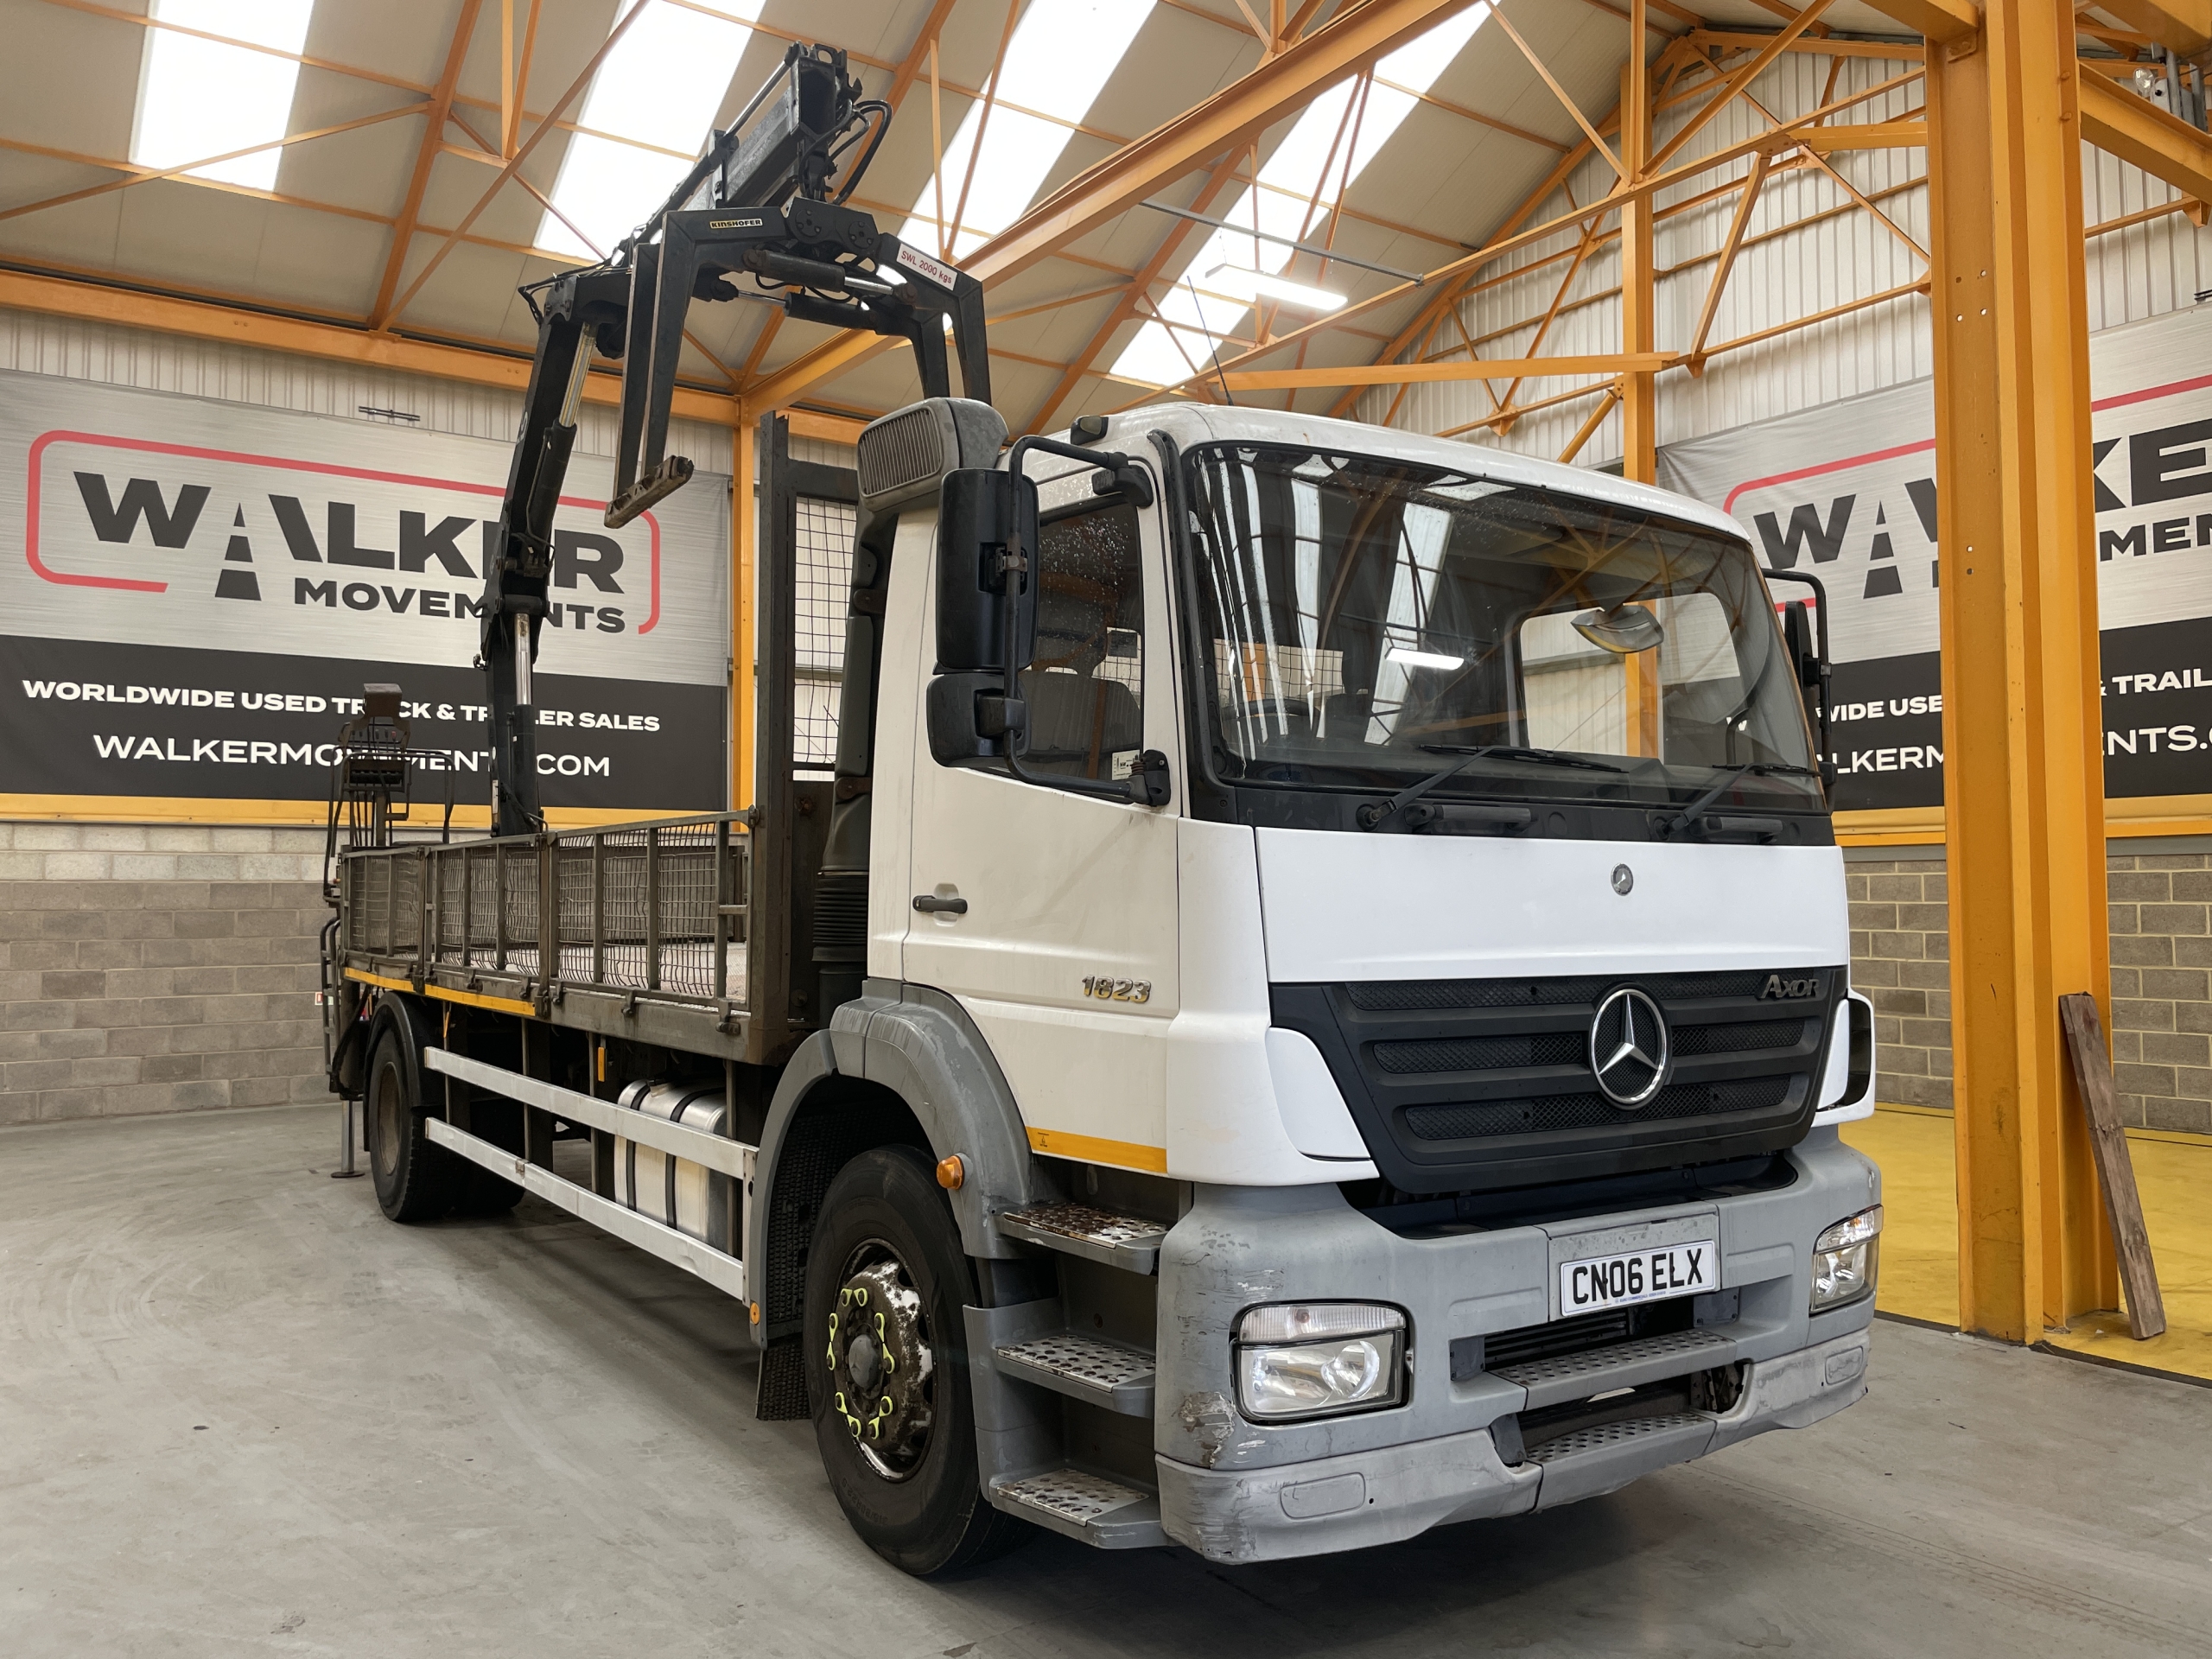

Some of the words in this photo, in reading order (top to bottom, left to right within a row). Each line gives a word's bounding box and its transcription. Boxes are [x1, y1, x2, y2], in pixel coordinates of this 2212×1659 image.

[901, 251, 917, 265] SWL
[918, 260, 938, 275] 2000
[938, 270, 952, 283] kgs
[73, 471, 624, 601] WALKR
[295, 577, 626, 634] MOVEMNTS
[22, 679, 235, 709] WORLDWIDE
[241, 692, 327, 713] USED
[332, 697, 431, 719] TRCK
[436, 703, 456, 721] &
[461, 705, 574, 727] TRER
[579, 712, 660, 732] SALES
[1890, 695, 1942, 716] USE
[1082, 975, 1152, 1004] 1823
[1573, 1257, 1643, 1305] CN06
[1651, 1248, 1703, 1291] ELX
